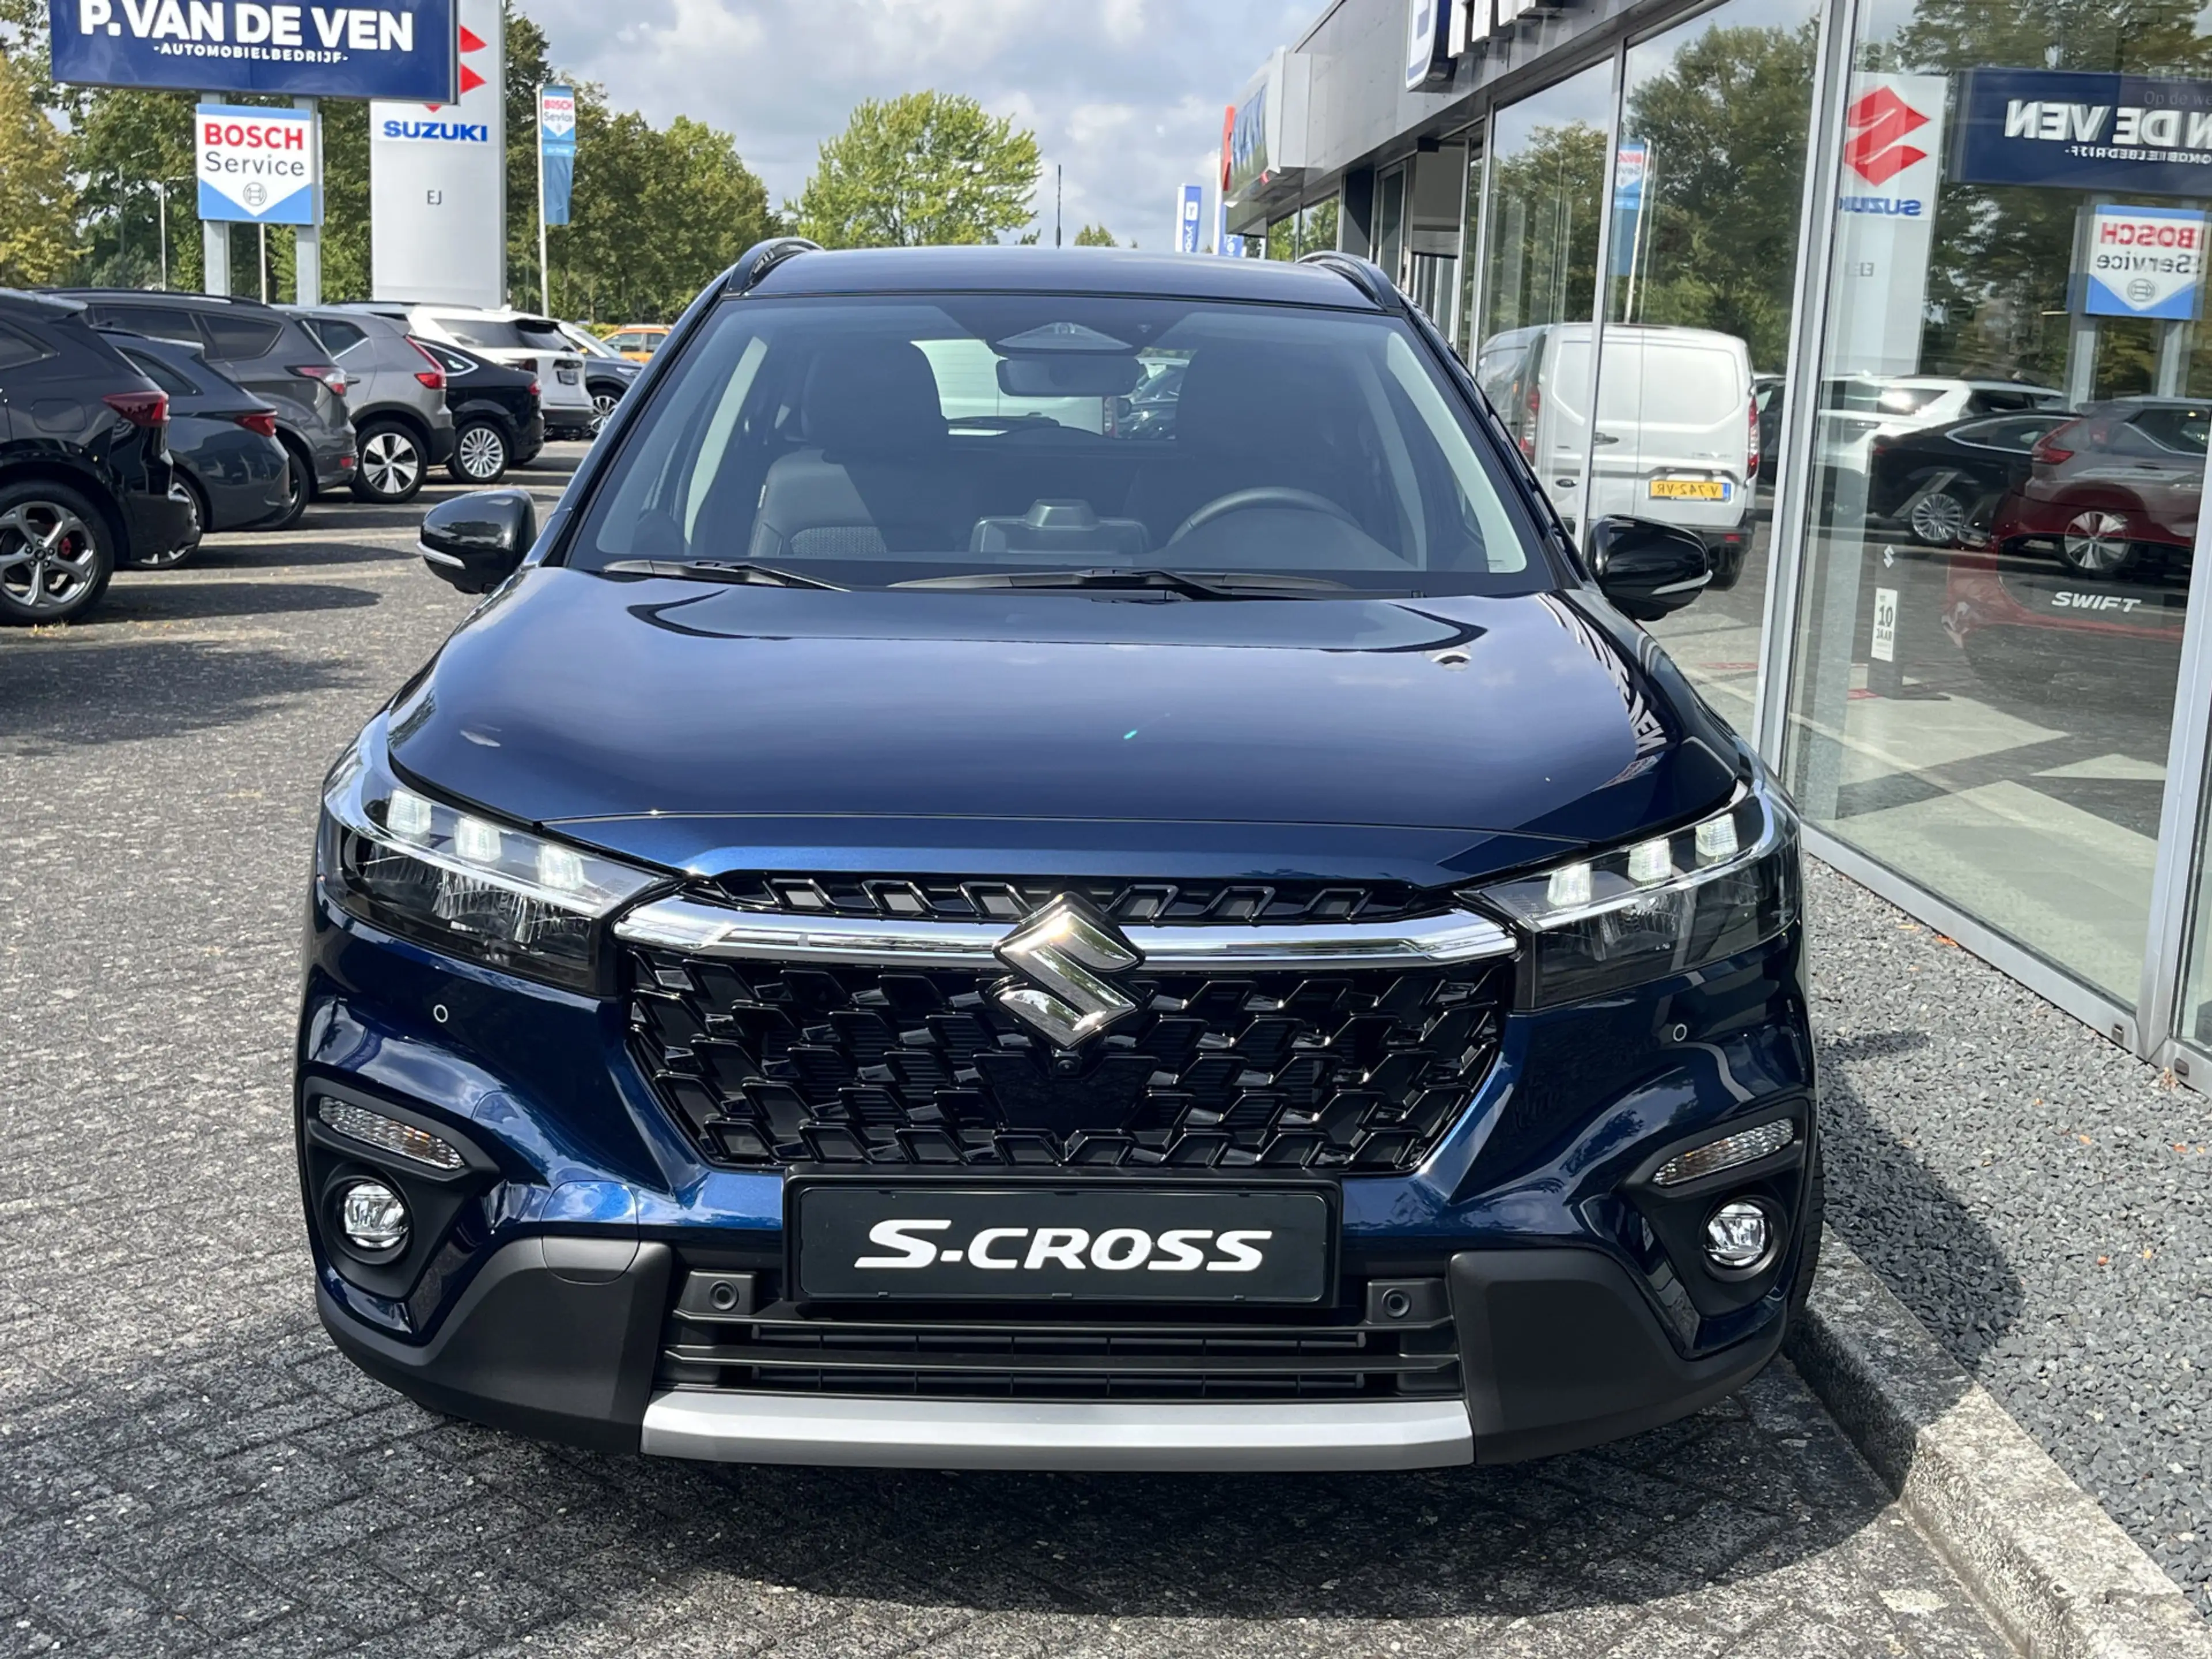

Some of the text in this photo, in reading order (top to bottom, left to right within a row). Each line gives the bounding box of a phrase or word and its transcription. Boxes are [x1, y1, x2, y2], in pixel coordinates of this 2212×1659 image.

[235, 2, 302, 46] DE
[310, 6, 414, 52] VEN
[204, 123, 304, 150] BOSCH
[382, 119, 488, 143] SUZUKI
[204, 151, 305, 177] Service
[426, 190, 442, 206] EJ
[2051, 590, 2142, 613] SWIFT
[1878, 604, 1893, 627] 10
[854, 1219, 1273, 1272] S-CROSS
